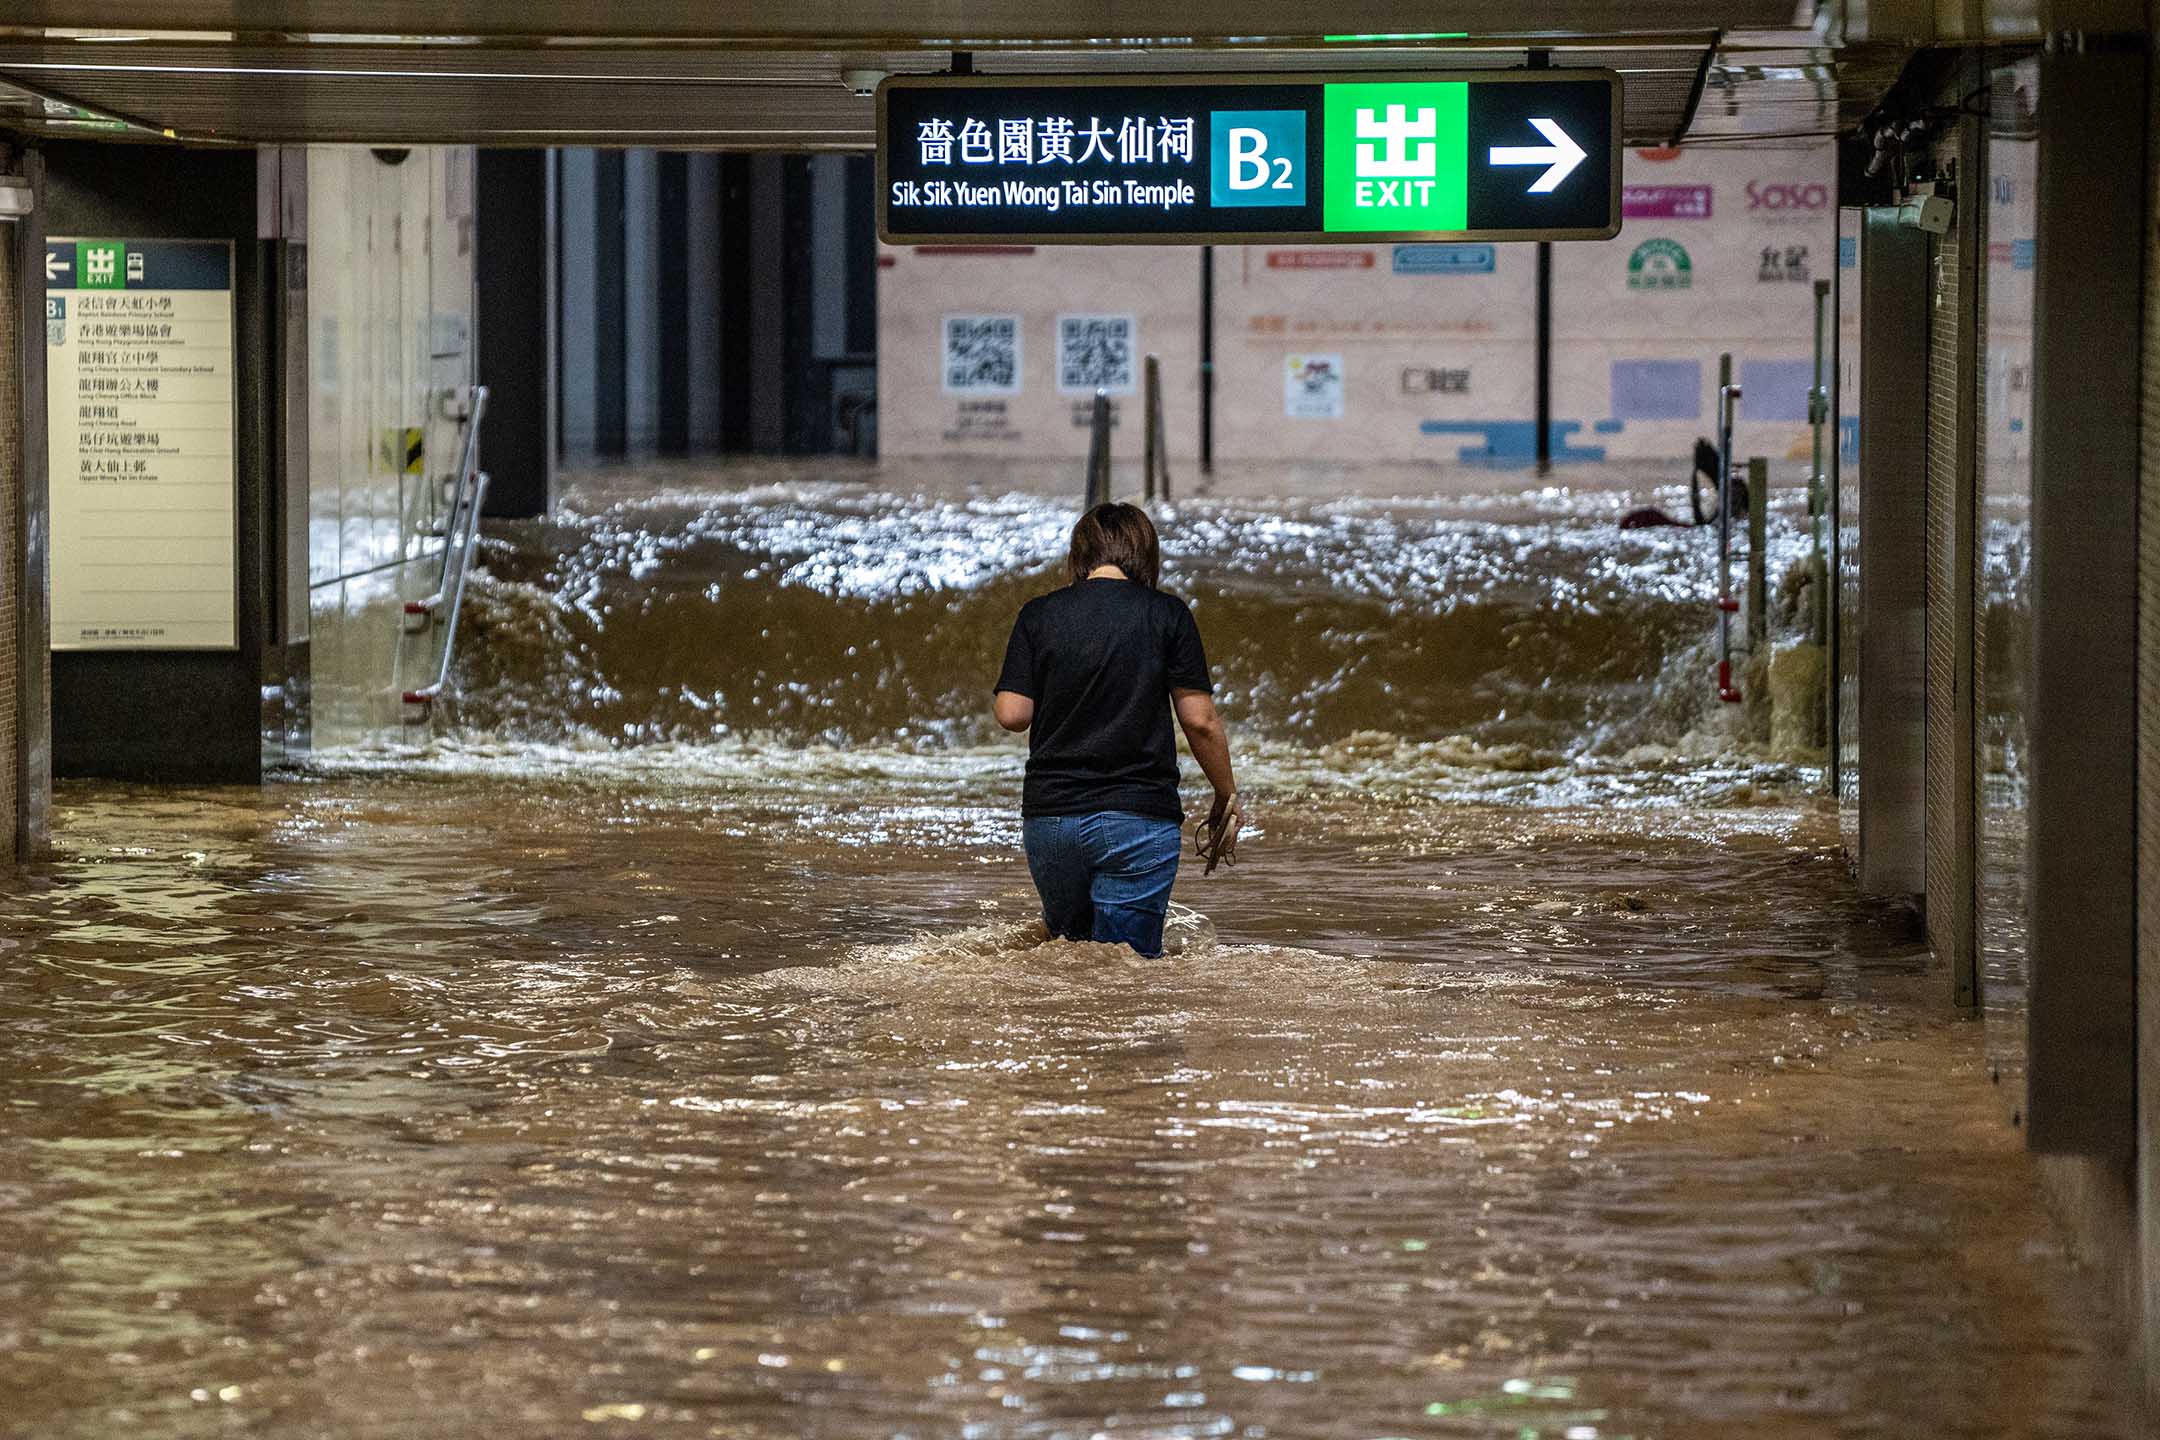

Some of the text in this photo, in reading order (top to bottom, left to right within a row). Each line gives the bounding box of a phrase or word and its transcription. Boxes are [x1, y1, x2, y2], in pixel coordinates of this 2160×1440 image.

[917, 116, 1195, 166] 嗇色園黃大仙祠
[1228, 127, 1293, 191] B2
[892, 179, 1195, 211] Sik Sik Yuen Wong Tai Sin Temple
[1355, 180, 1437, 207] EXIT
[87, 273, 113, 284] EXIT
